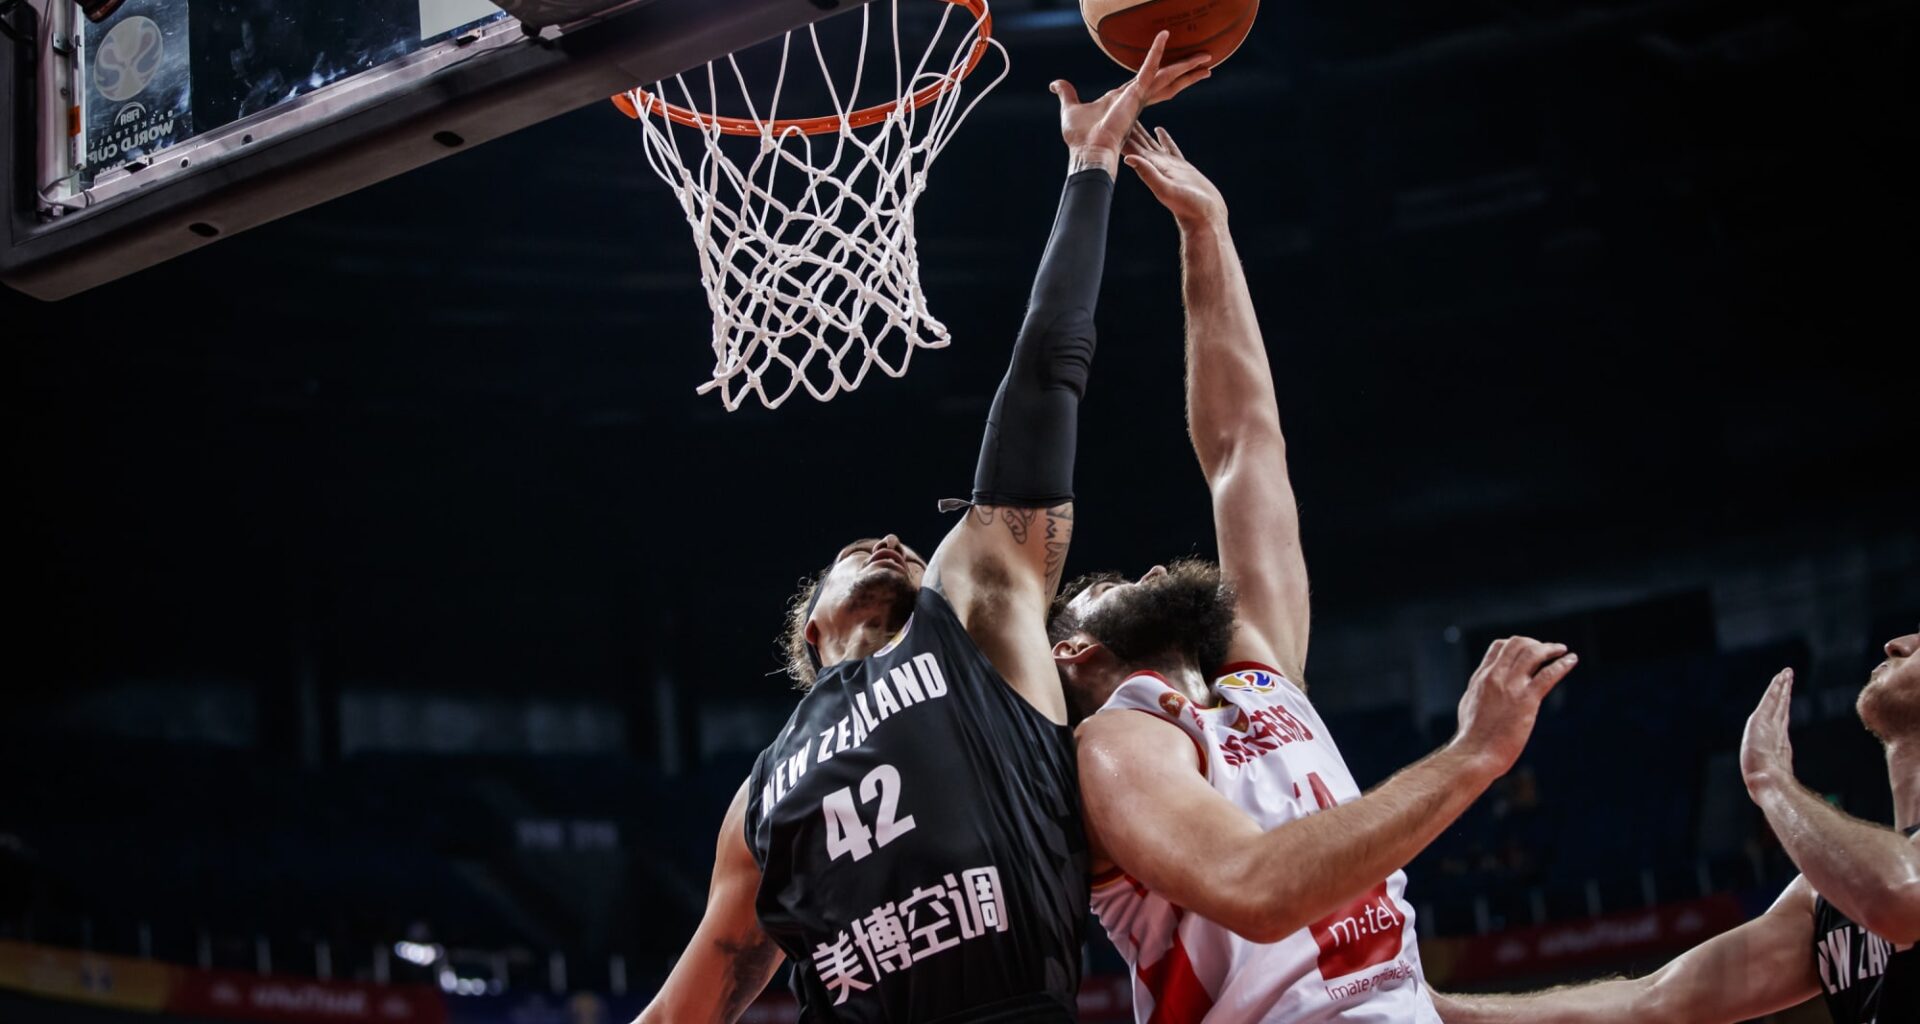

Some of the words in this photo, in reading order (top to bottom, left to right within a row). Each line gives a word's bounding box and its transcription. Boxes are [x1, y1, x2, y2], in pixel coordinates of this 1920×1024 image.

[762, 737, 812, 818] NEW
[817, 652, 947, 763] ZEALAND
[823, 764, 916, 862] 42
[812, 866, 1009, 1006] 美博空调
[1328, 896, 1400, 947] m:tel
[1325, 978, 1370, 1000] Imate
